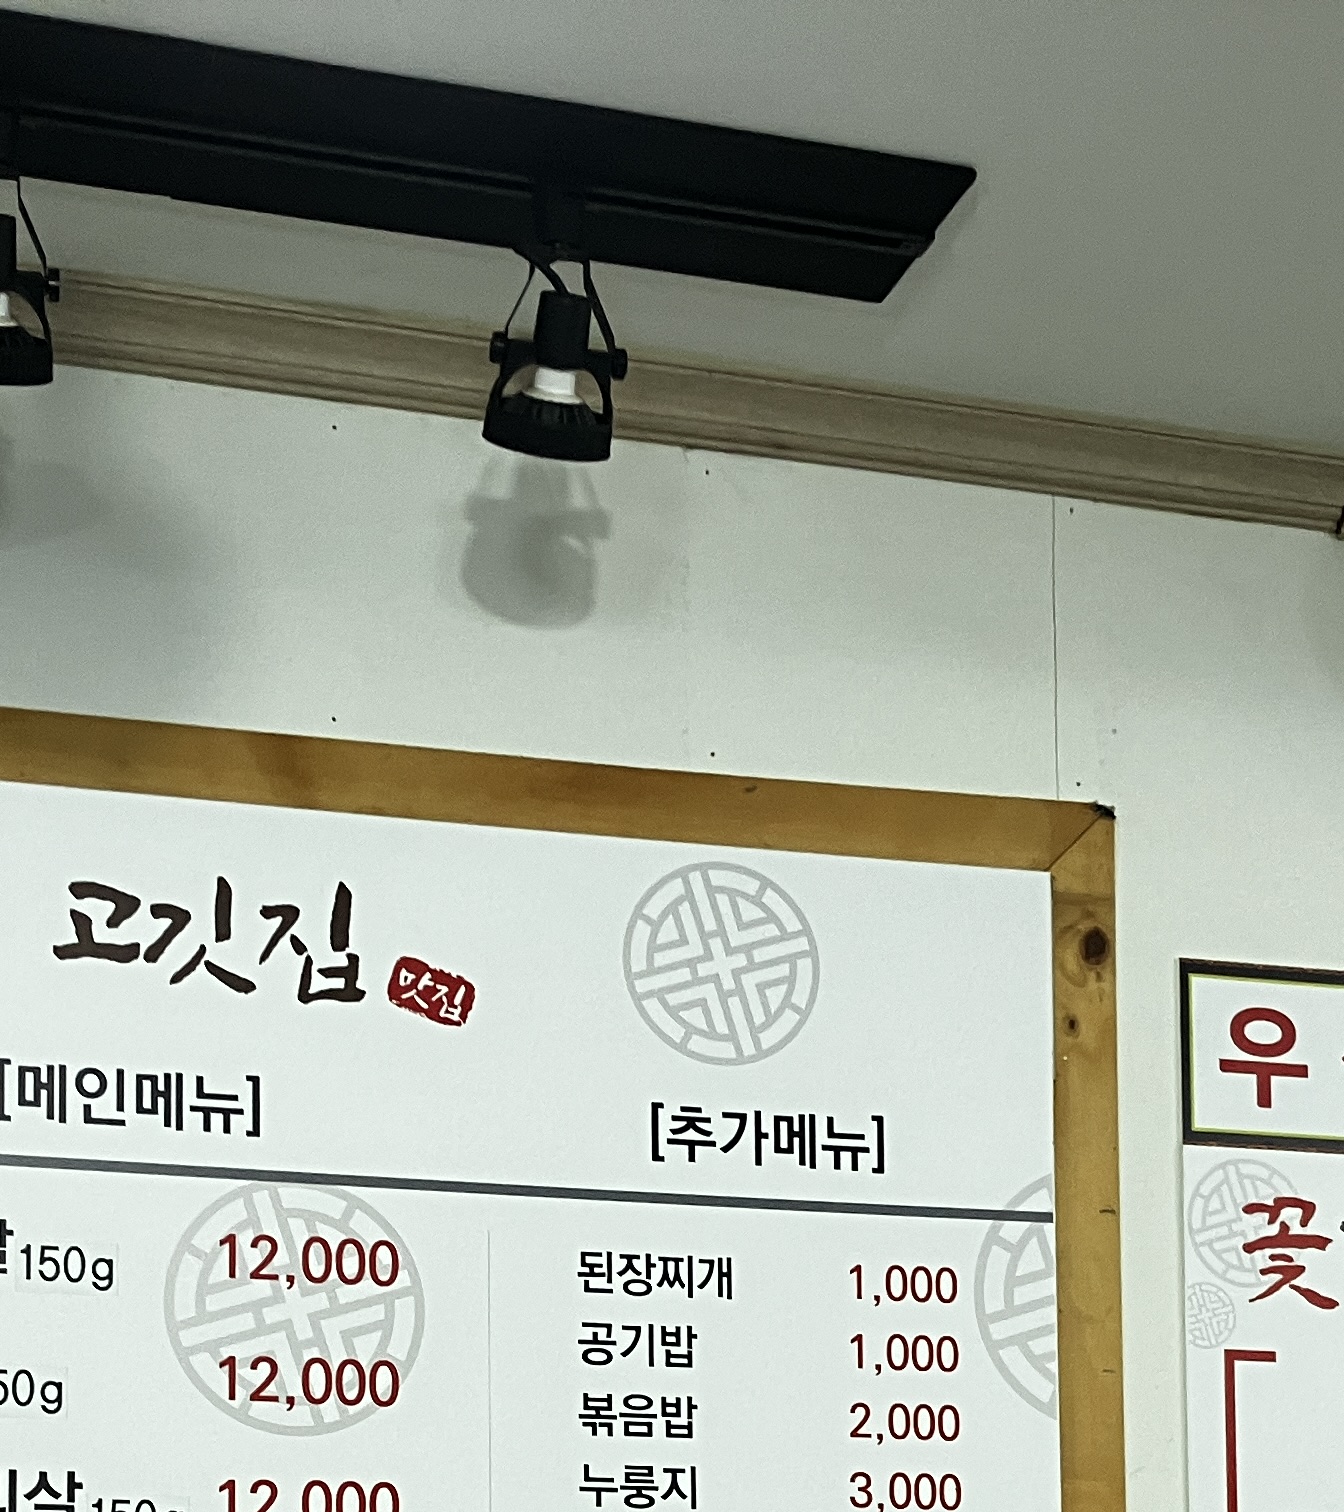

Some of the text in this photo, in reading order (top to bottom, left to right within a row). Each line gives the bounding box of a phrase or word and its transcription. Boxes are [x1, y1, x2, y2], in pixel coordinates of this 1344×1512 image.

[52, 875, 367, 1005] 고깃집
[399, 968, 465, 1021] 맛집
[650, 1101, 885, 1175] [추가메뉴]
[20, 1243, 114, 1292] 150g
[218, 1233, 400, 1290] 12,000
[577, 1250, 958, 1308] 된장찌개 1,000
[577, 1321, 960, 1376] 공기밥 1,000
[218, 1355, 400, 1412] 12,000
[578, 1392, 960, 1446] 볶음밥 2,000
[578, 1463, 697, 1510] 누룽지
